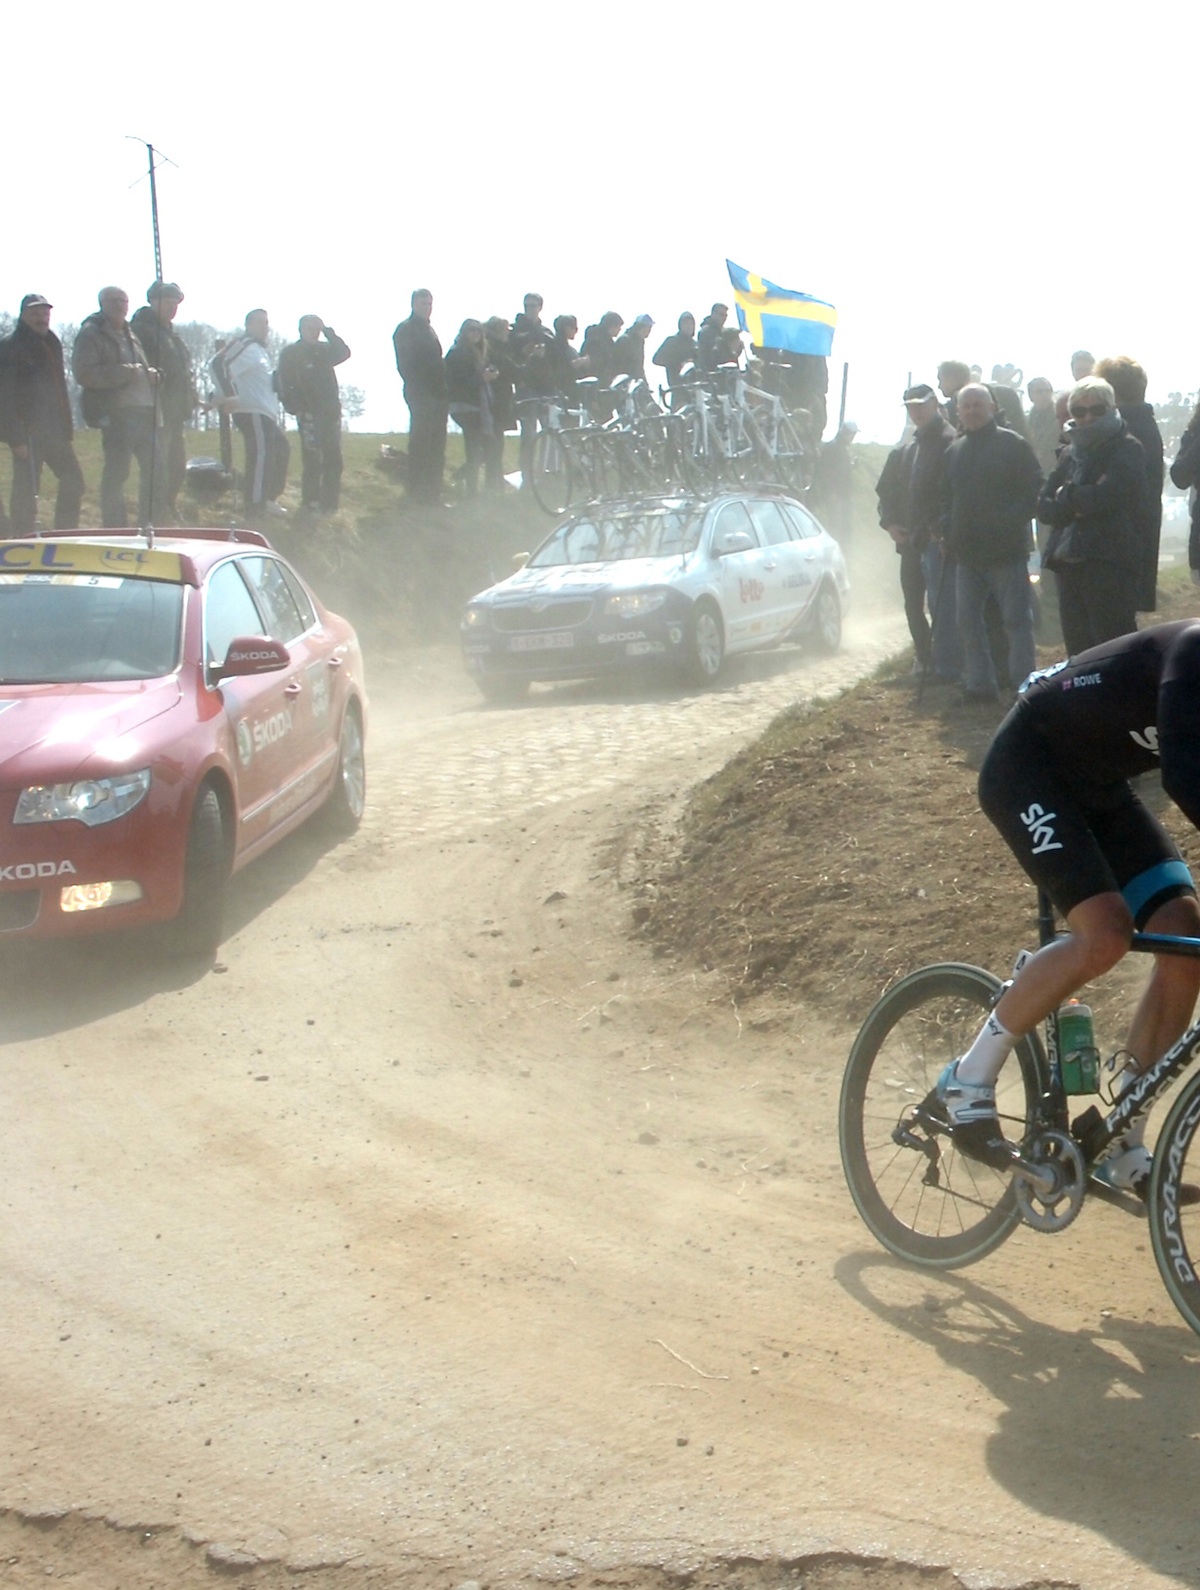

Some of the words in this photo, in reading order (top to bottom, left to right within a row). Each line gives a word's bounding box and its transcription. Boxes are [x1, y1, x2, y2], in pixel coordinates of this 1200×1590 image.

[0, 544, 74, 568] CL
[105, 550, 149, 563] LCL
[1073, 672, 1102, 688] ROWE
[0, 859, 77, 880] KODA
